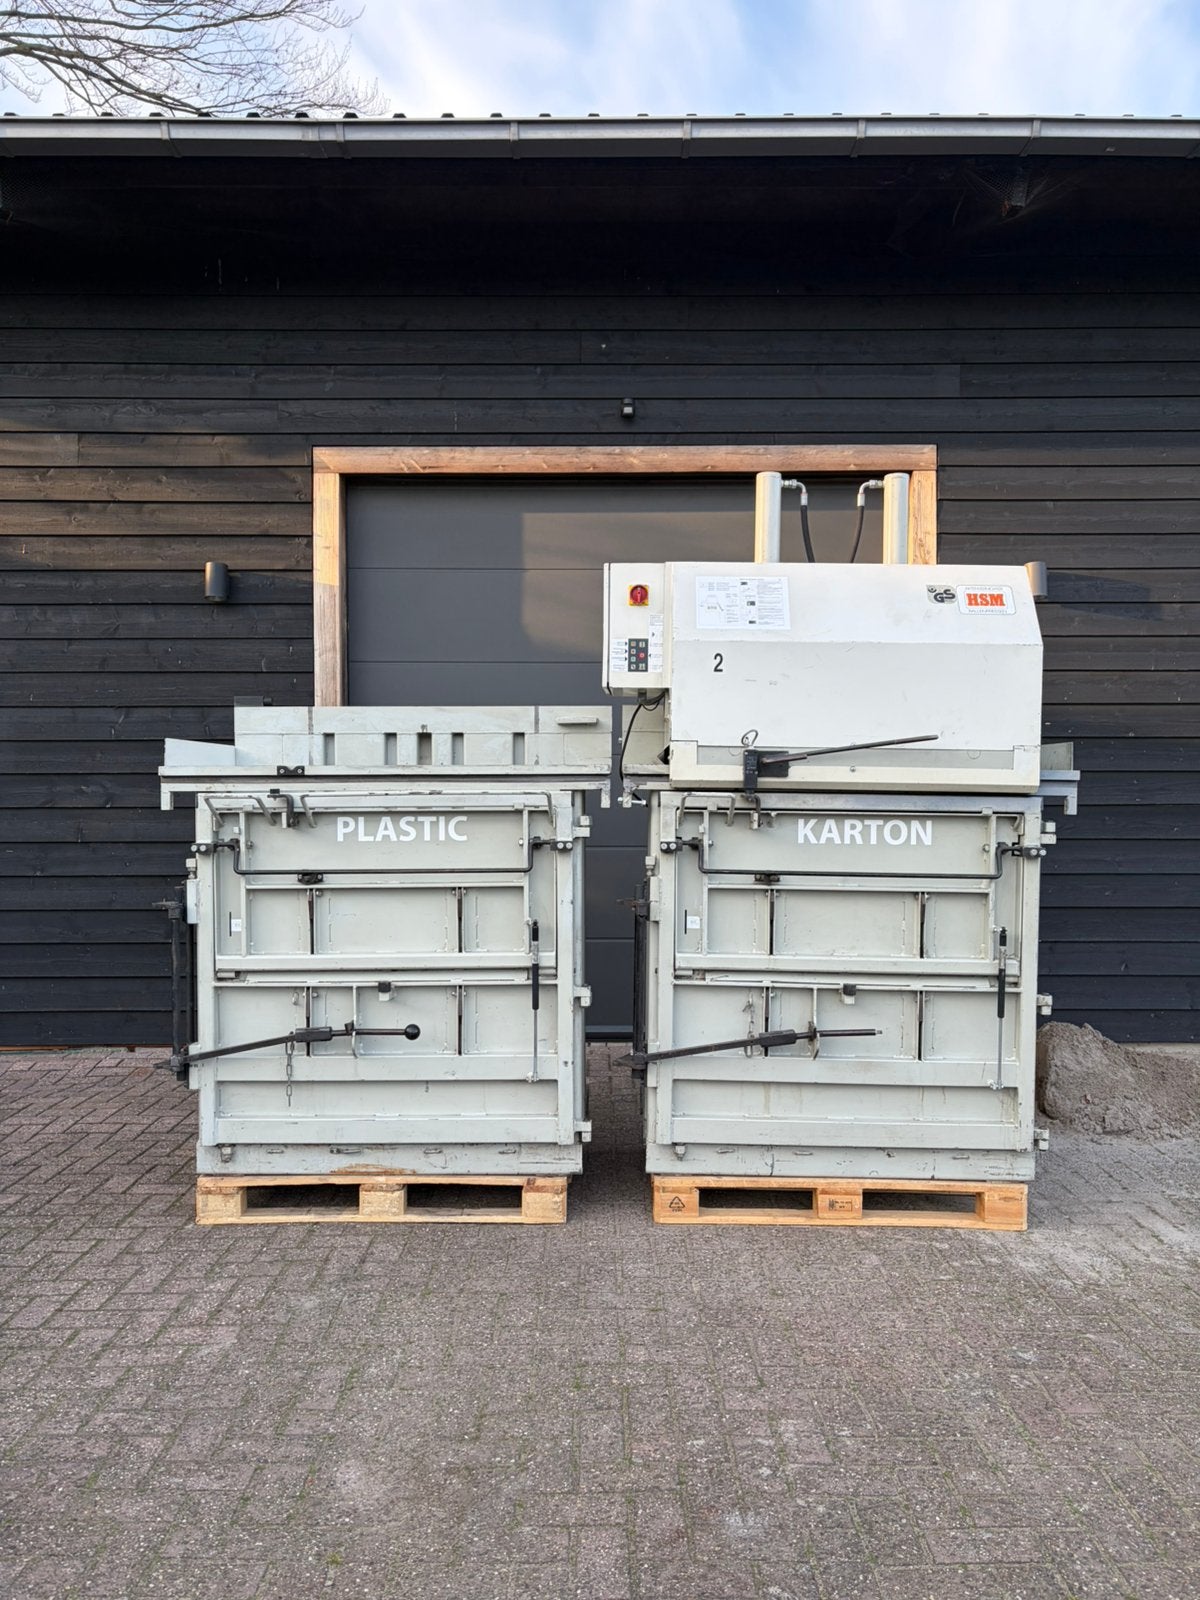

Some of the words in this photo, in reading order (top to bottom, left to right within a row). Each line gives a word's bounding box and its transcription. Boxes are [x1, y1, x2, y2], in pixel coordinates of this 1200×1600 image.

[934, 589, 956, 603] GS
[966, 593, 1006, 606] HSM
[713, 653, 724, 672] 2
[336, 815, 468, 842] PLASTIC
[797, 818, 933, 846] KARTON
